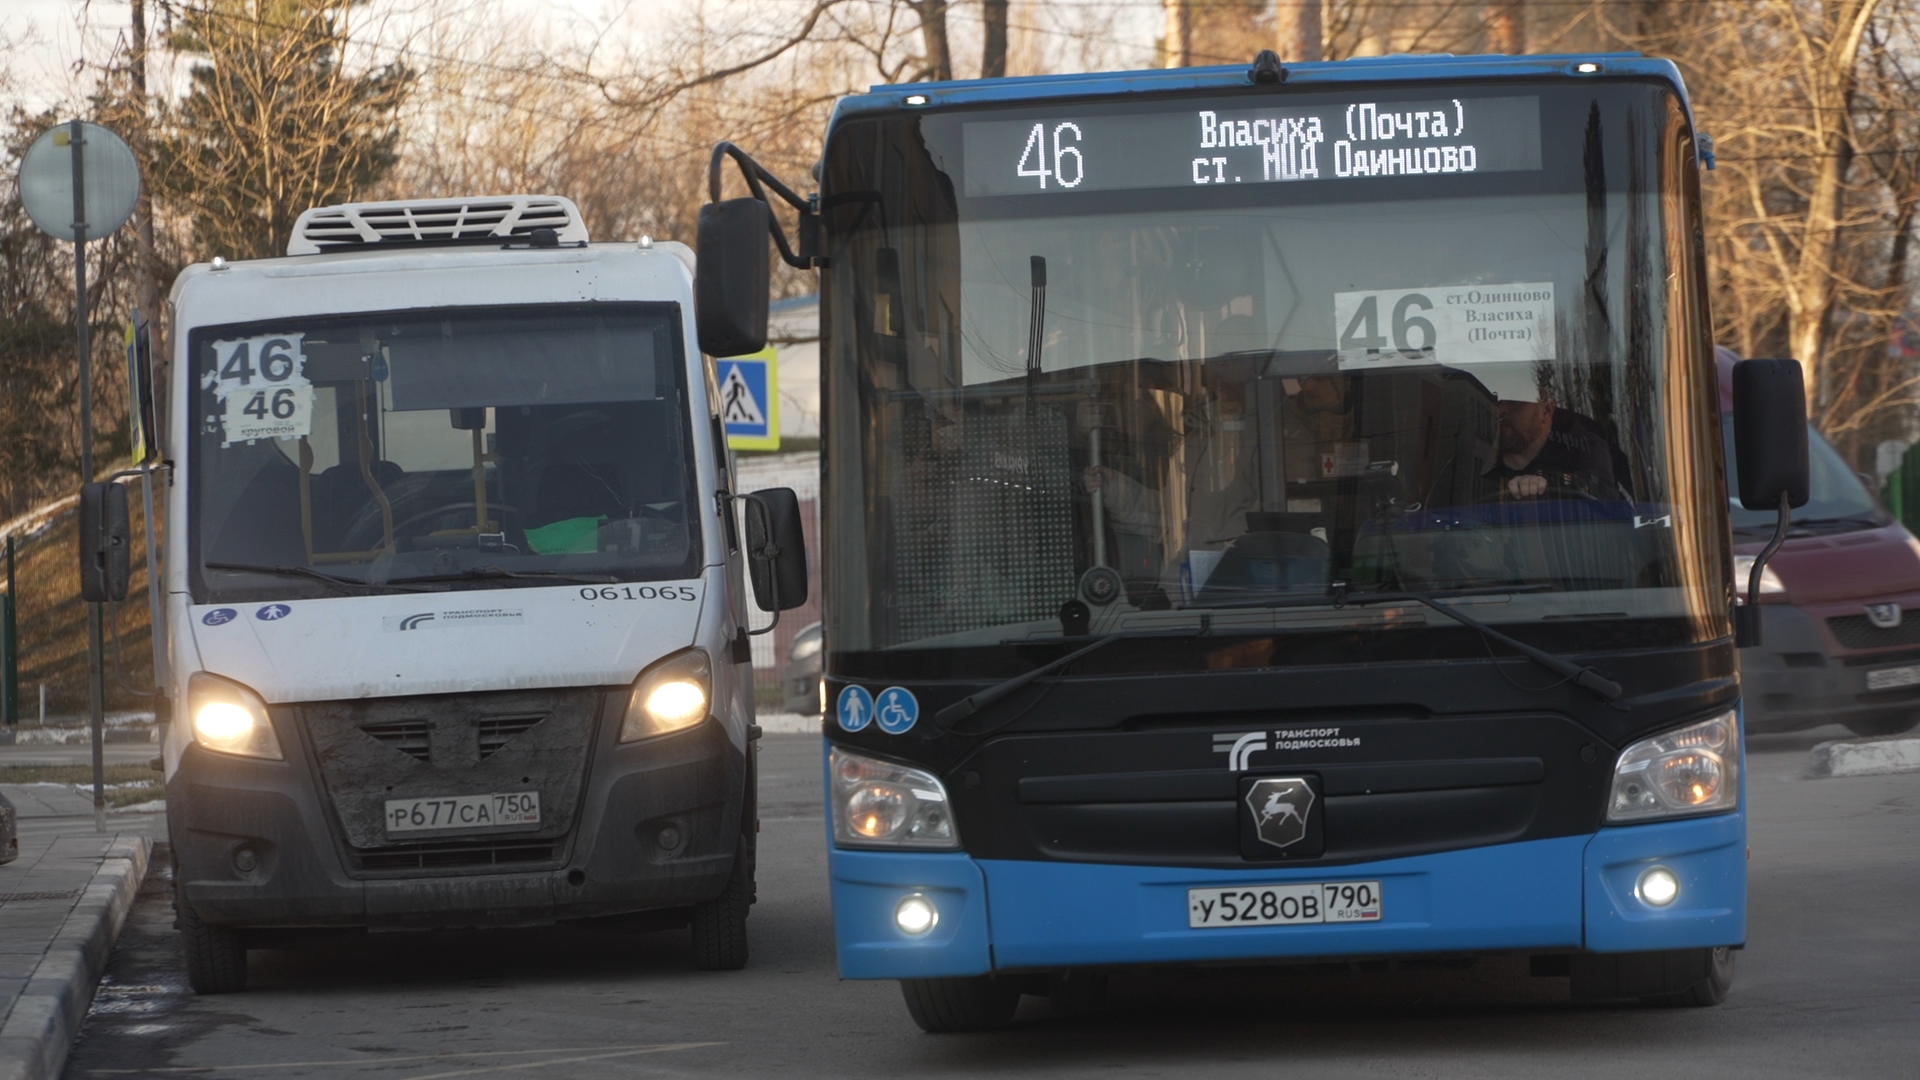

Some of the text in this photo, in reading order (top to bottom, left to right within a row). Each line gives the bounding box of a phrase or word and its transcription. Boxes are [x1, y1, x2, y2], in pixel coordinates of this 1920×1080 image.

[1200, 100, 1464, 148] Власиха (Почта)
[1017, 122, 1084, 189] 46
[1192, 140, 1477, 184] ст. МЦД Одинцово
[1446, 290, 1552, 306] ст.Одинцово
[1340, 293, 1437, 360] 46
[1465, 309, 1533, 323] Власиха
[1468, 327, 1532, 344] (Почта)
[220, 338, 294, 385] 46
[243, 388, 295, 420] 46
[579, 586, 697, 601] 061065
[1275, 728, 1340, 739] ТРАНСПОРТ
[1275, 738, 1361, 750] ПОДМОСКОВЬЯ
[394, 794, 532, 827] Р677СА 750
[504, 813, 523, 821] RUS
[1200, 885, 1371, 923] У528ОВ 790
[1337, 909, 1360, 918] RUS
